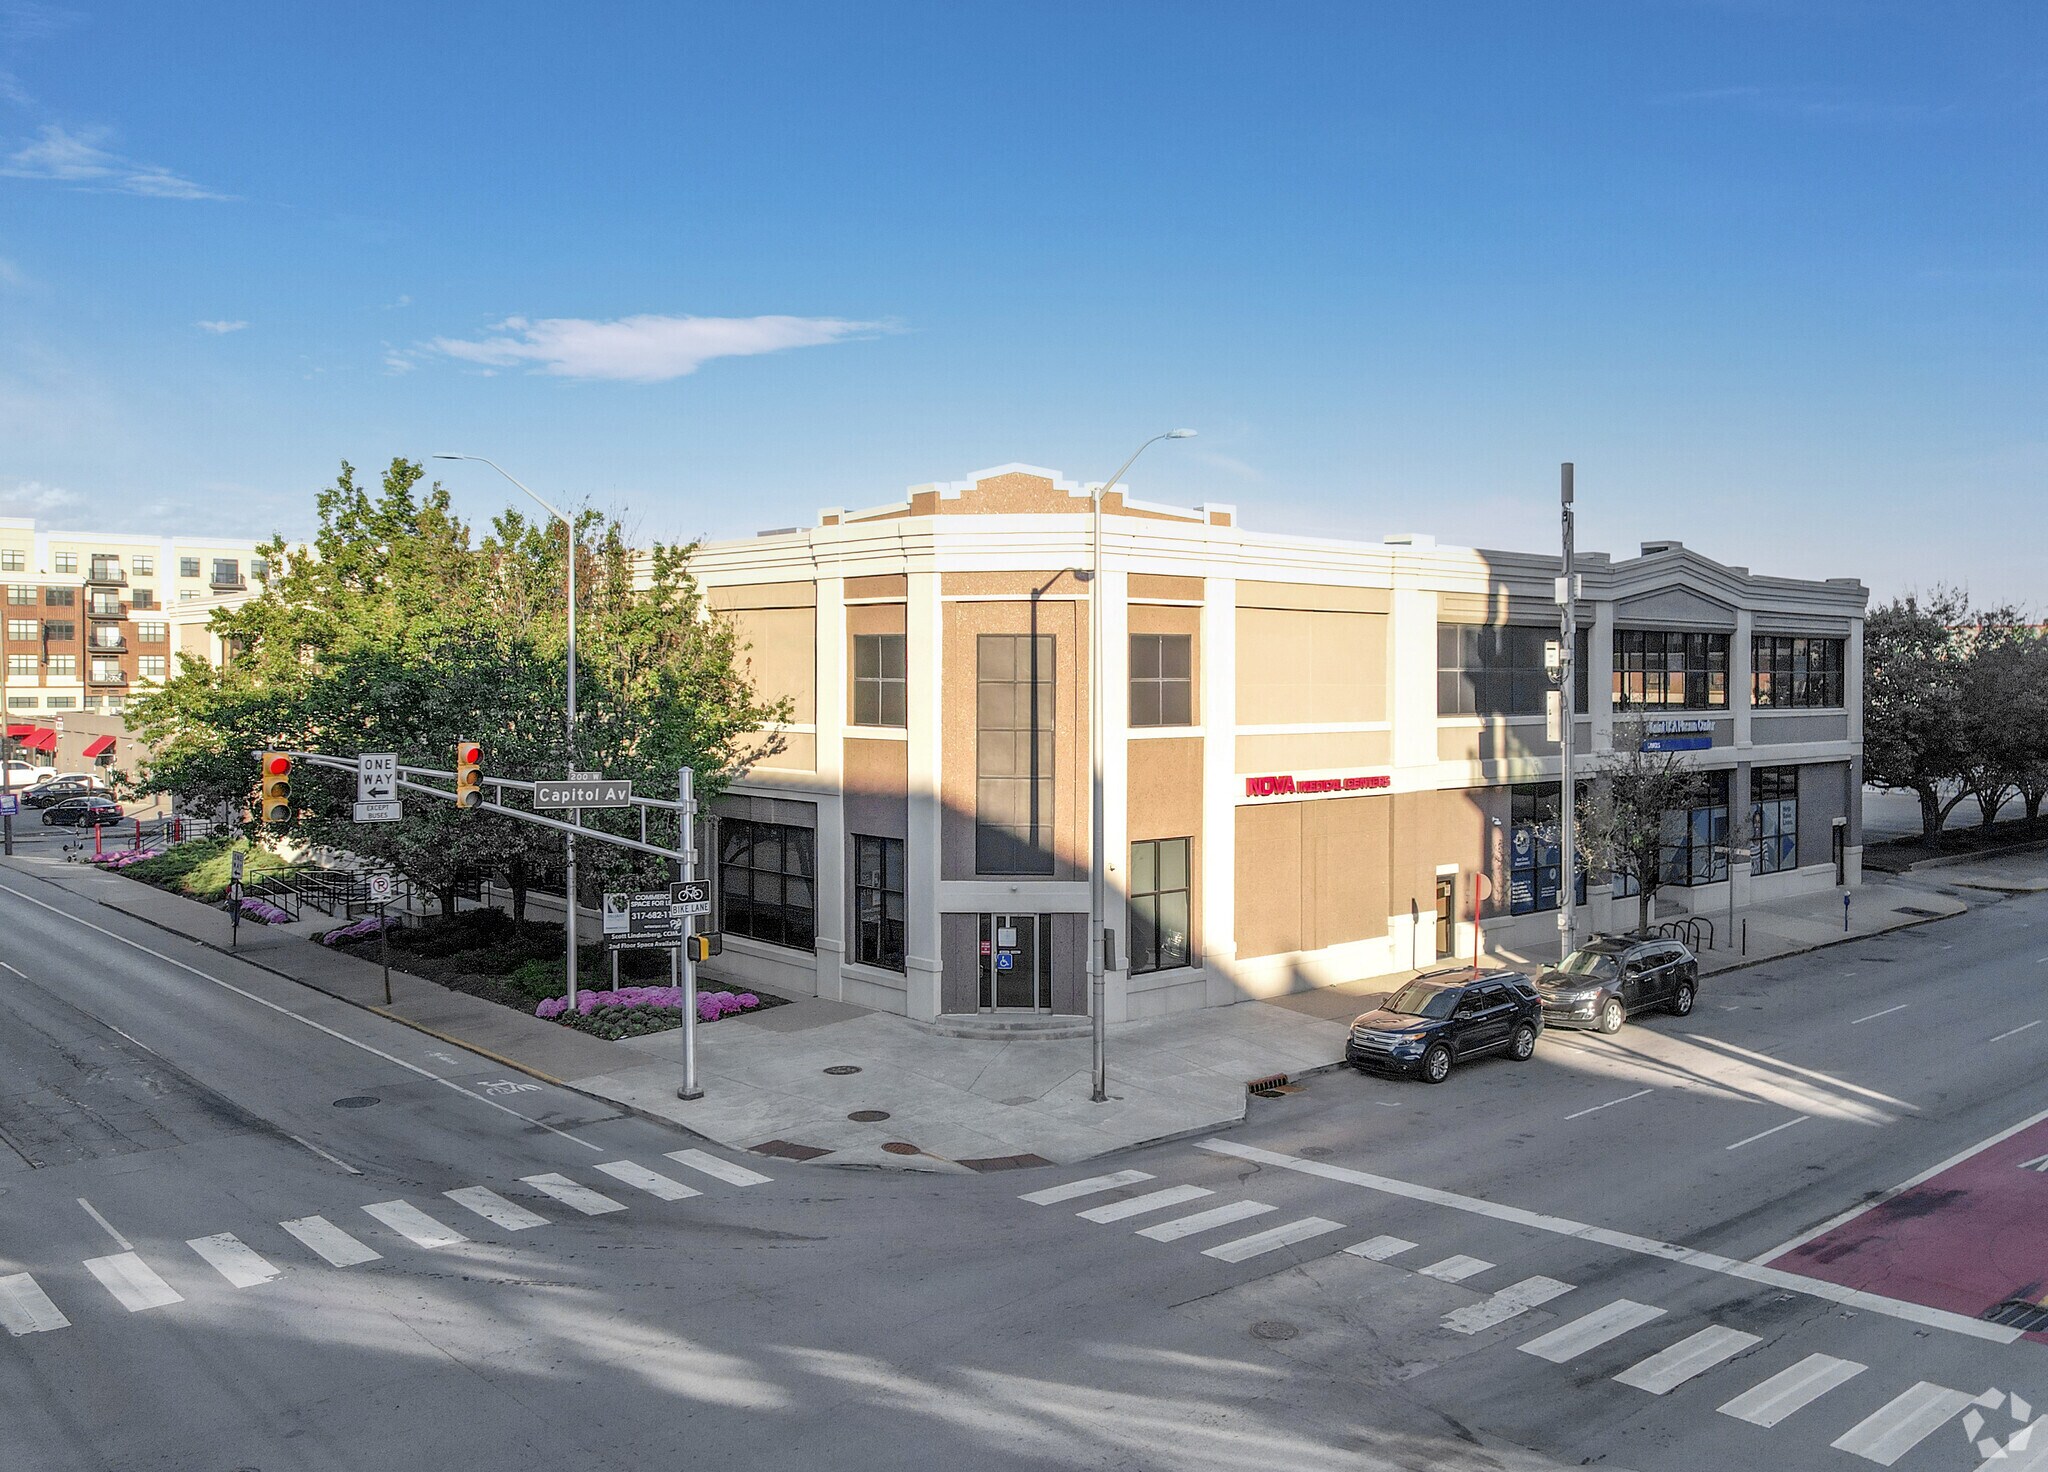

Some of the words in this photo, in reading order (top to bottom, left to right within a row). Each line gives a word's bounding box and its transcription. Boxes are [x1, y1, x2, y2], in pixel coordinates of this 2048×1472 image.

[365, 758, 392, 770] ONE
[363, 774, 393, 785] WAY
[570, 773, 588, 781] 200
[1246, 775, 1296, 797] NOVA
[1343, 775, 1391, 791] CENTERS
[539, 788, 599, 804] Capitol
[604, 787, 626, 800] Av
[672, 904, 689, 914] BIKE
[691, 902, 709, 912] LANE
[631, 911, 672, 920] 317-682-11
